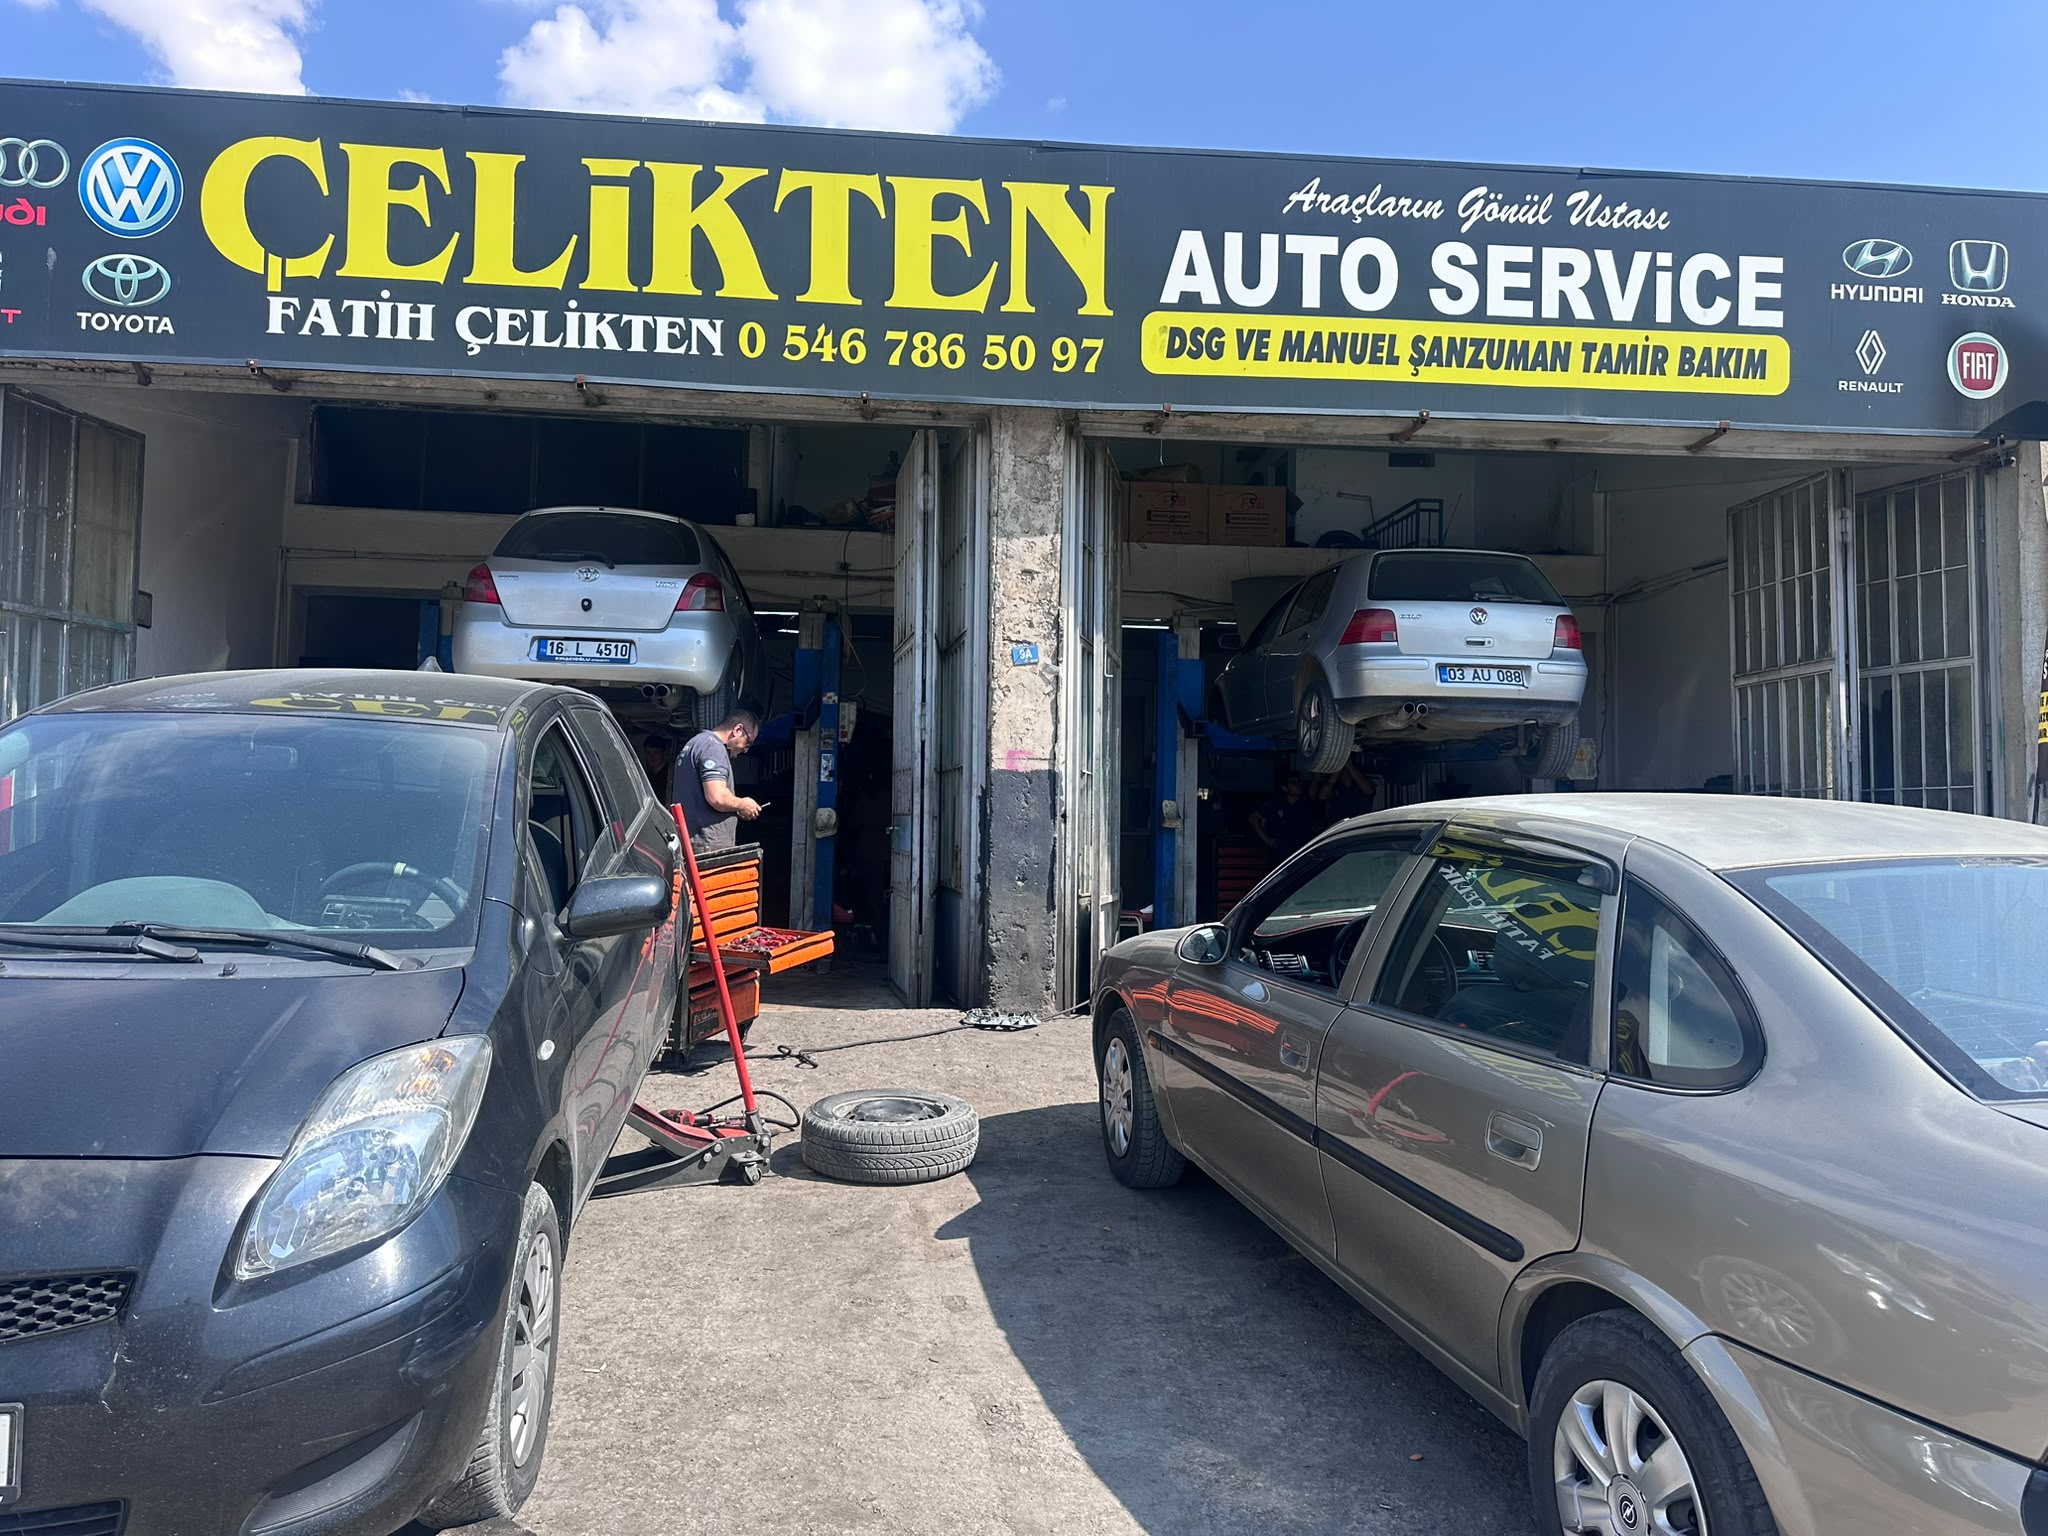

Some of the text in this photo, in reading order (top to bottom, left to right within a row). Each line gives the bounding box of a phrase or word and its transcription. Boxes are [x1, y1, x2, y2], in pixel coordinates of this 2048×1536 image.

[1283, 176, 1670, 234] Araçların Gönül Ustası
[1159, 230, 1399, 312] AUTO
[1831, 284, 1923, 303] HYUNDAI
[1941, 294, 2016, 308] HONDA
[77, 312, 175, 334] TOYOTA
[266, 289, 1104, 373] FATİH ÇELİKTEN 0 546 786 50 97
[1166, 327, 1768, 380] DSG VE MANUEL ŞANZUMAN TAMİR BAKIM
[1962, 351, 1995, 381] FIAT
[1838, 380, 1904, 393] RENAULT
[549, 641, 564, 655] 16
[575, 642, 583, 656] L
[596, 643, 628, 658] 4510
[1448, 668, 1465, 681] 03
[1472, 669, 1491, 682] AU
[1497, 670, 1522, 683] 088
